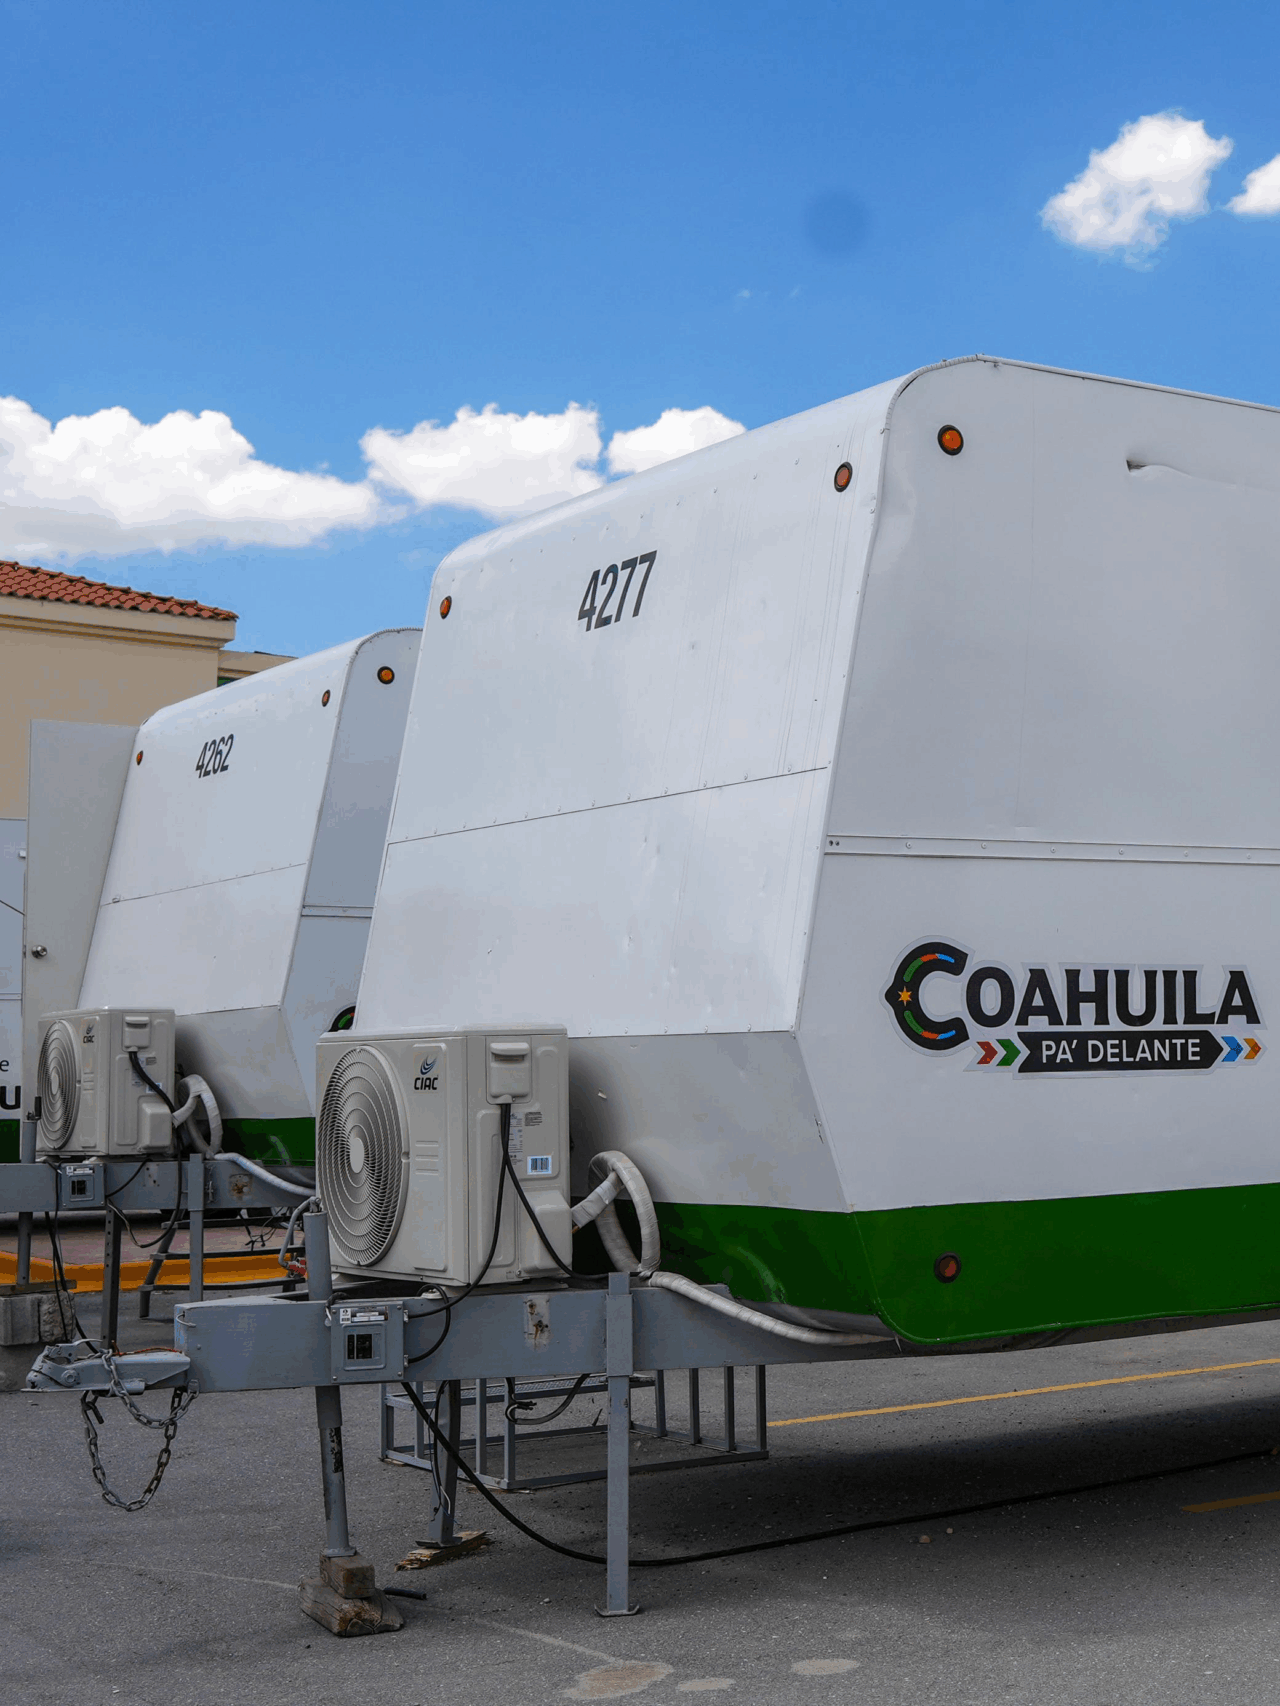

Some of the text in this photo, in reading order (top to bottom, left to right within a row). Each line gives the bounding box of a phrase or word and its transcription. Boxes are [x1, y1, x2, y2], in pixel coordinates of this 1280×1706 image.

[577, 549, 657, 632] 4277
[195, 733, 234, 779] 4262
[885, 941, 1261, 1051] COAHUILA
[1088, 1038, 1201, 1063] DELANTE
[414, 1077, 438, 1091] CIAC
